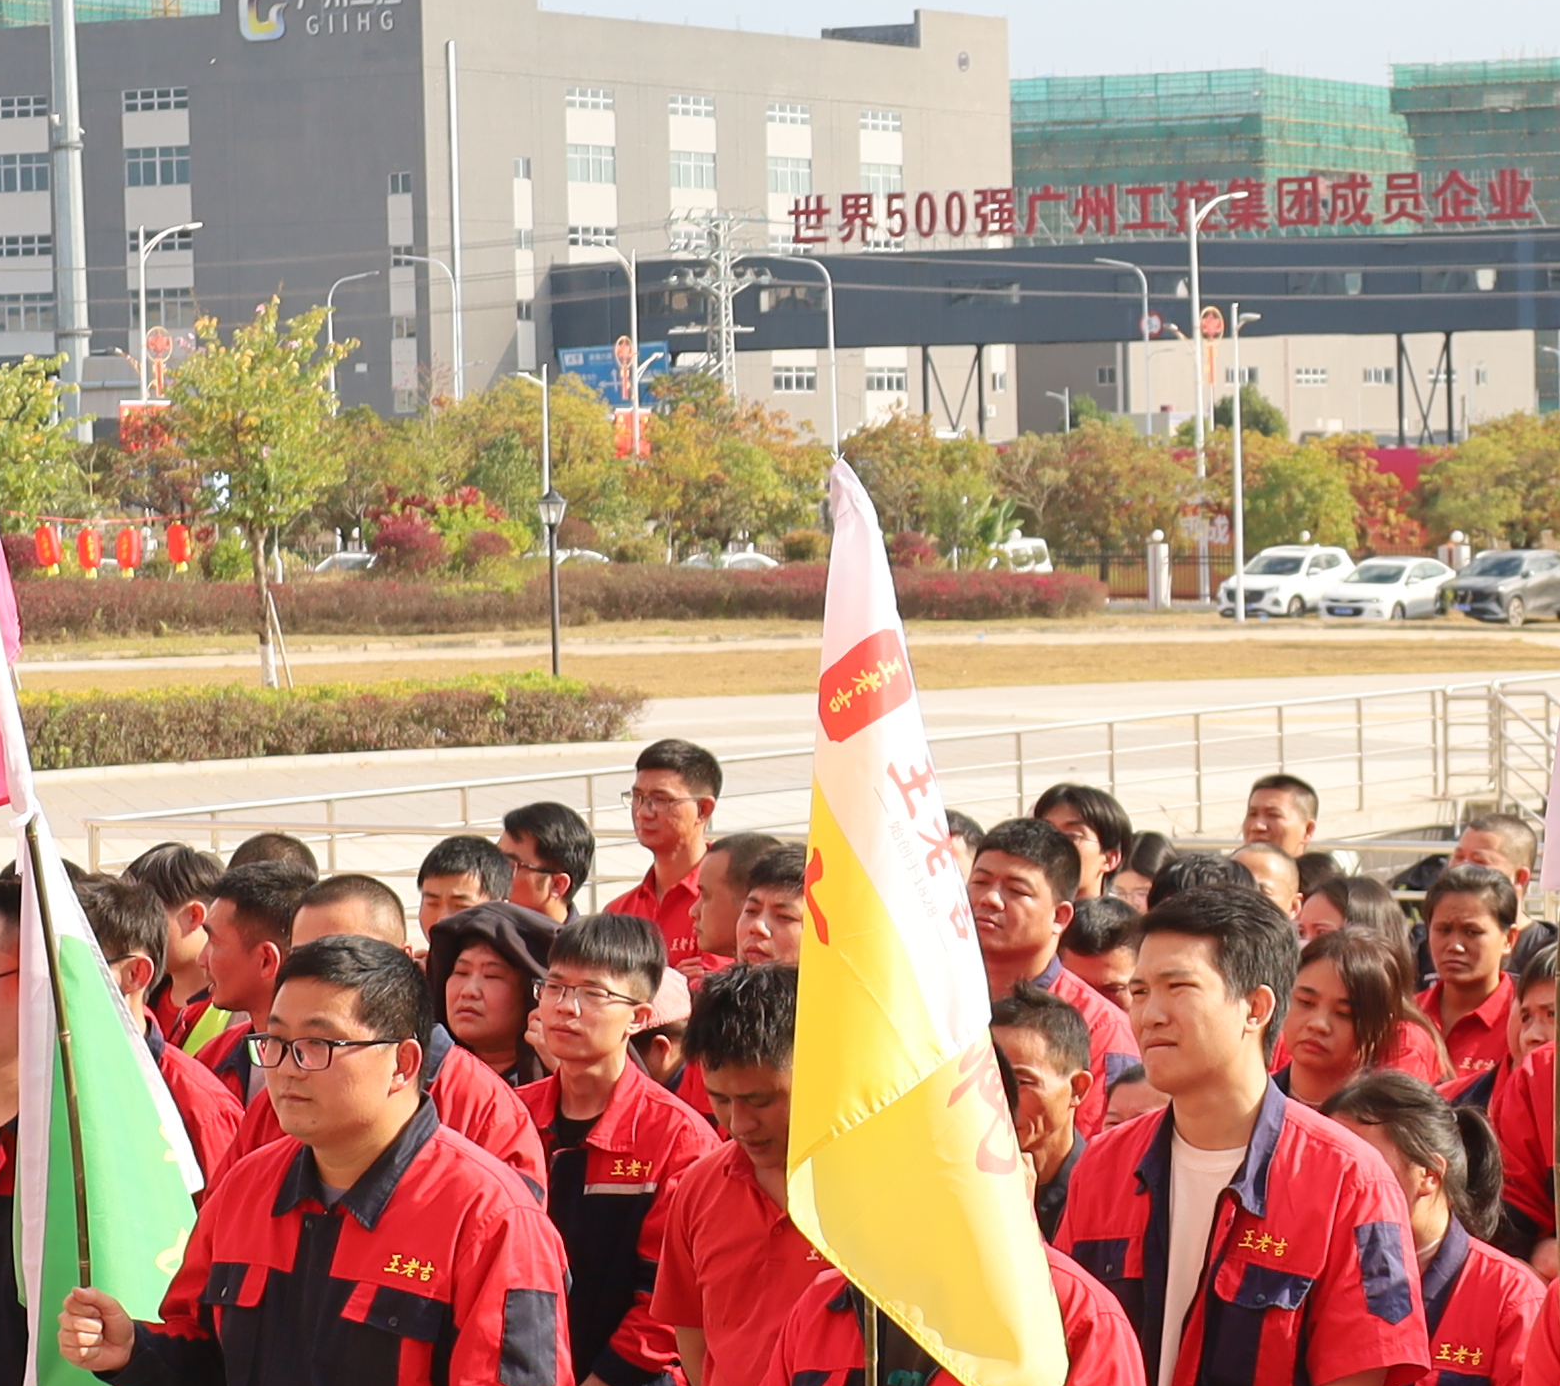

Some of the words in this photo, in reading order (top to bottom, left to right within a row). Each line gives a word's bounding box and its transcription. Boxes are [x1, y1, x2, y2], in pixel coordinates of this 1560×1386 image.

[305, 10, 395, 36] GIIHG
[787, 168, 1535, 245] 世界500强广州工控集团成员企业
[828, 657, 903, 714] 王老吉
[1239, 1229, 1288, 1257] 王老吉
[383, 1254, 435, 1281] 王老吉
[1435, 1343, 1483, 1366] 王老吉
